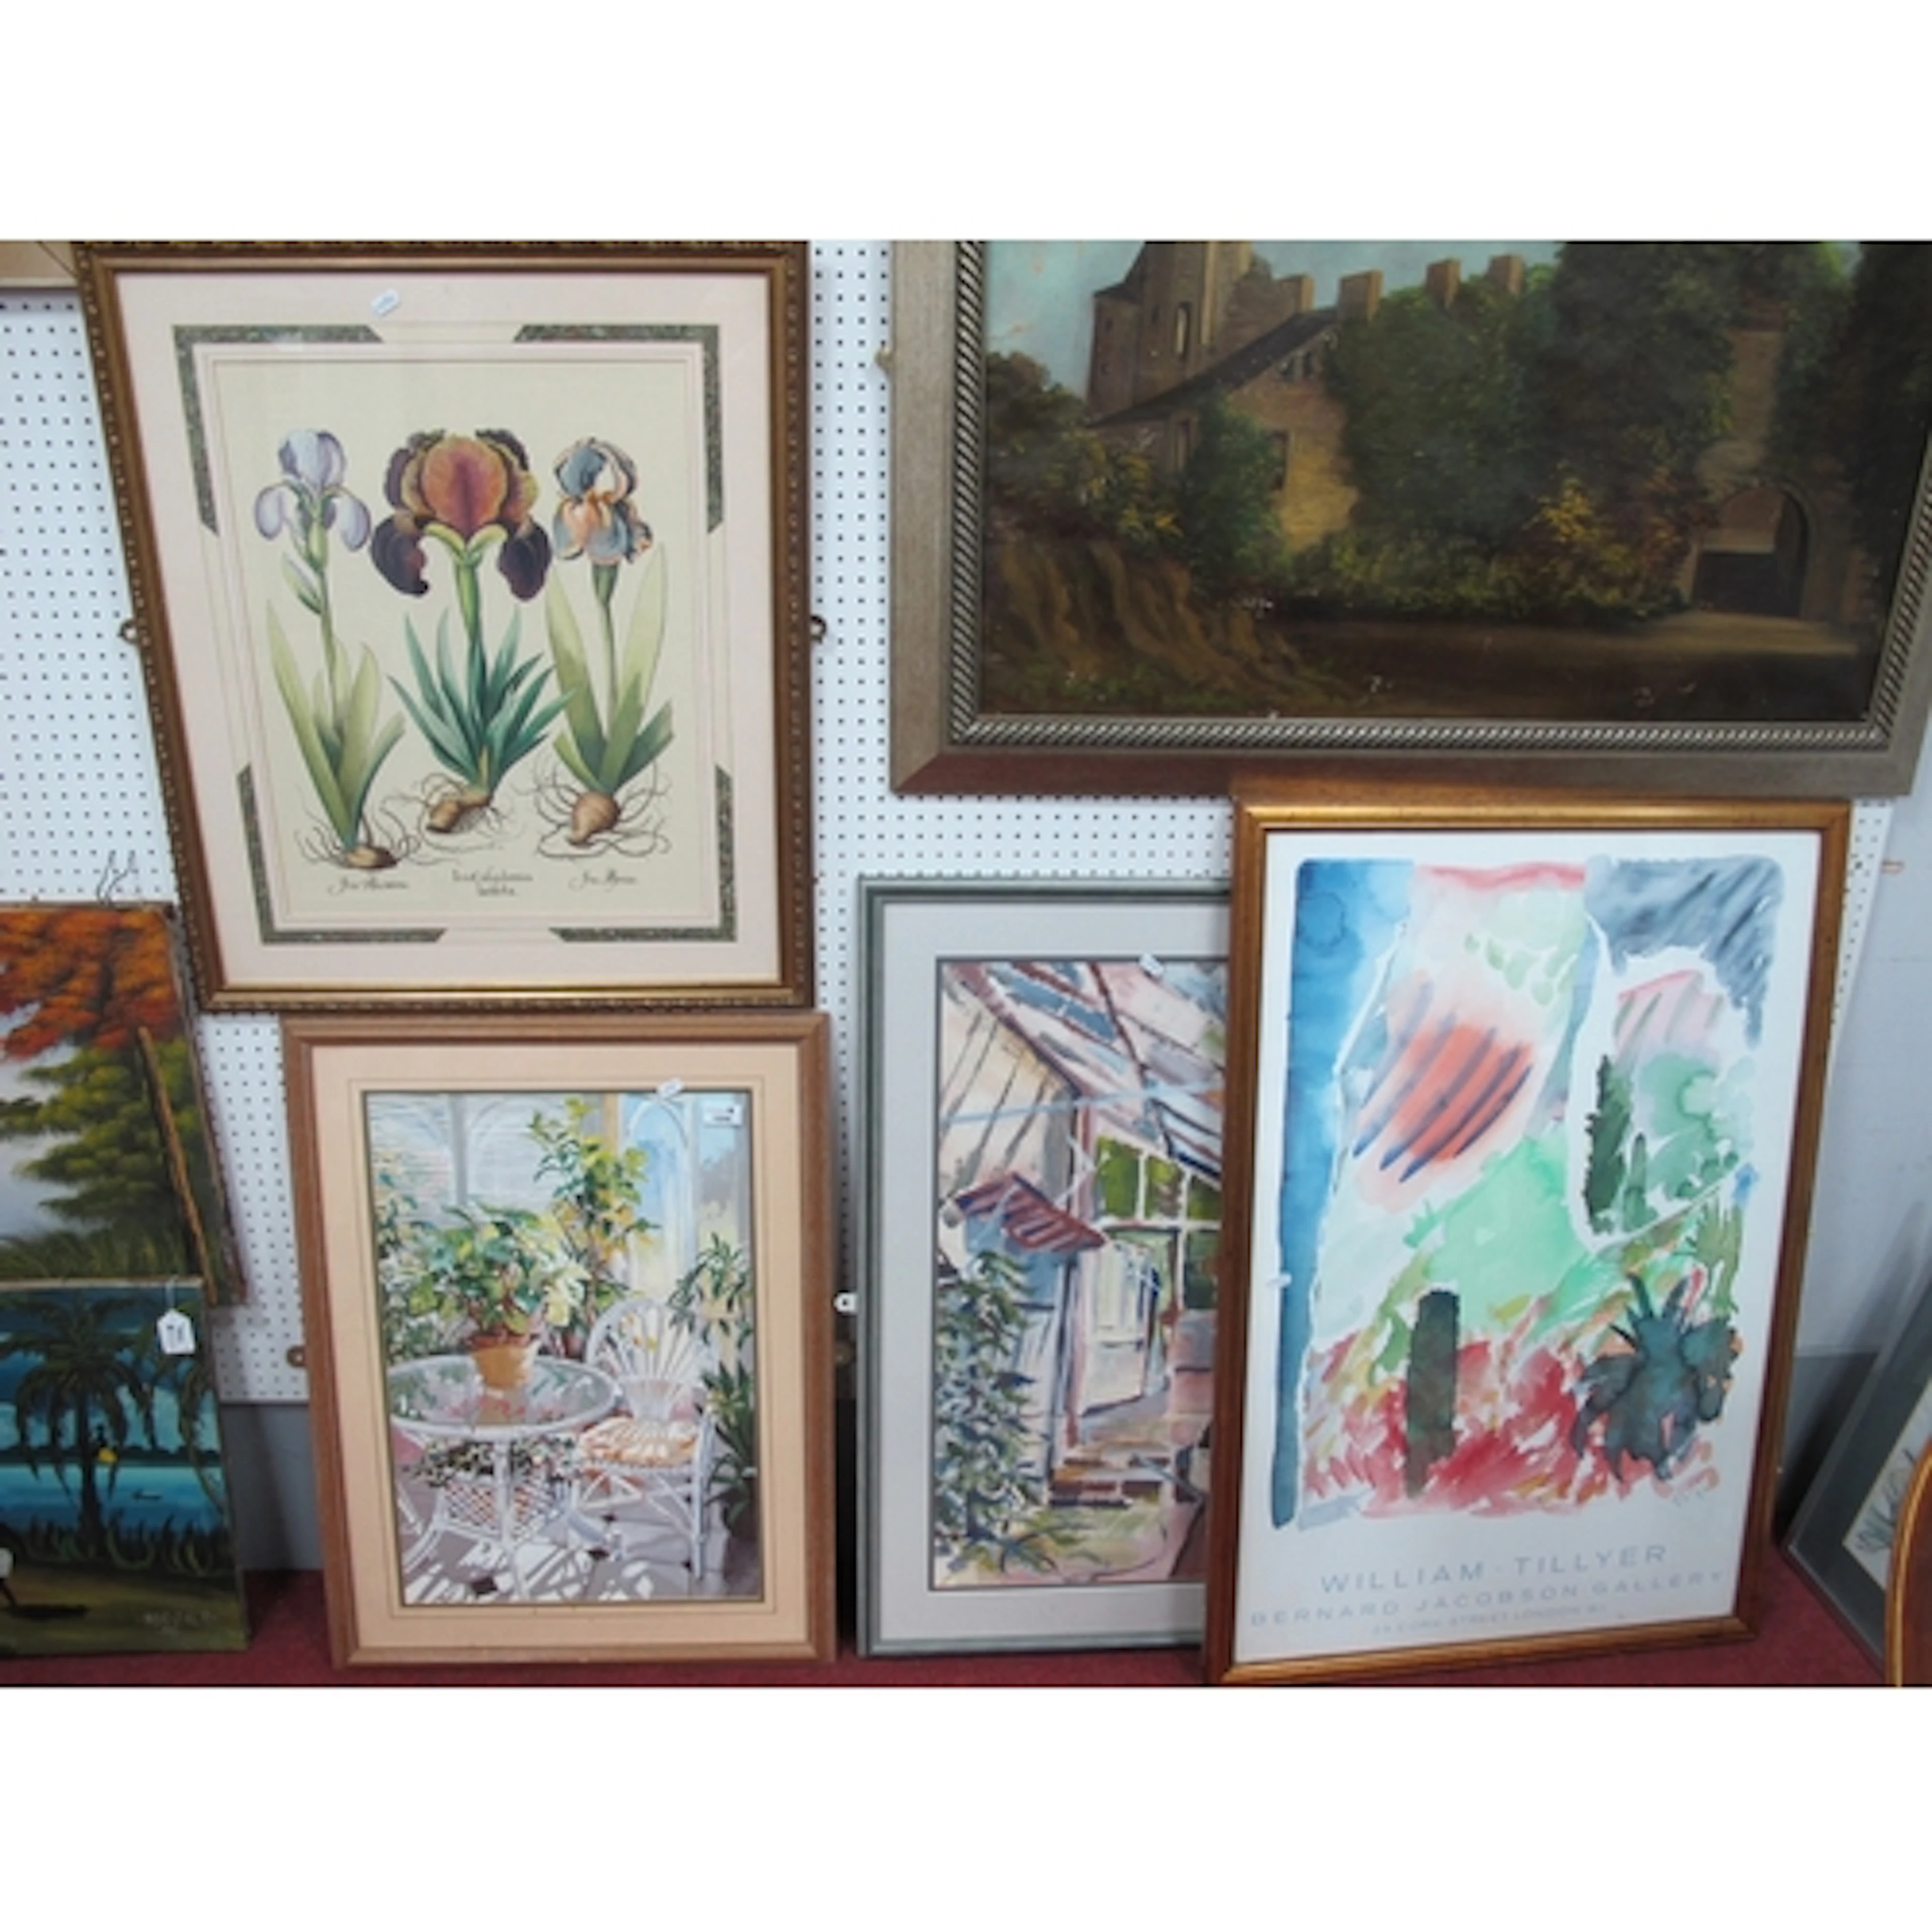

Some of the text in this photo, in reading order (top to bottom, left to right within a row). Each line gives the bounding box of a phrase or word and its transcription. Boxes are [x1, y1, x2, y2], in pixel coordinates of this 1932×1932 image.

[1321, 1544, 1668, 1594] WILLIAM TILLYER
[1250, 1569, 1725, 1627] BERNARD JACOBSON GALLERY
